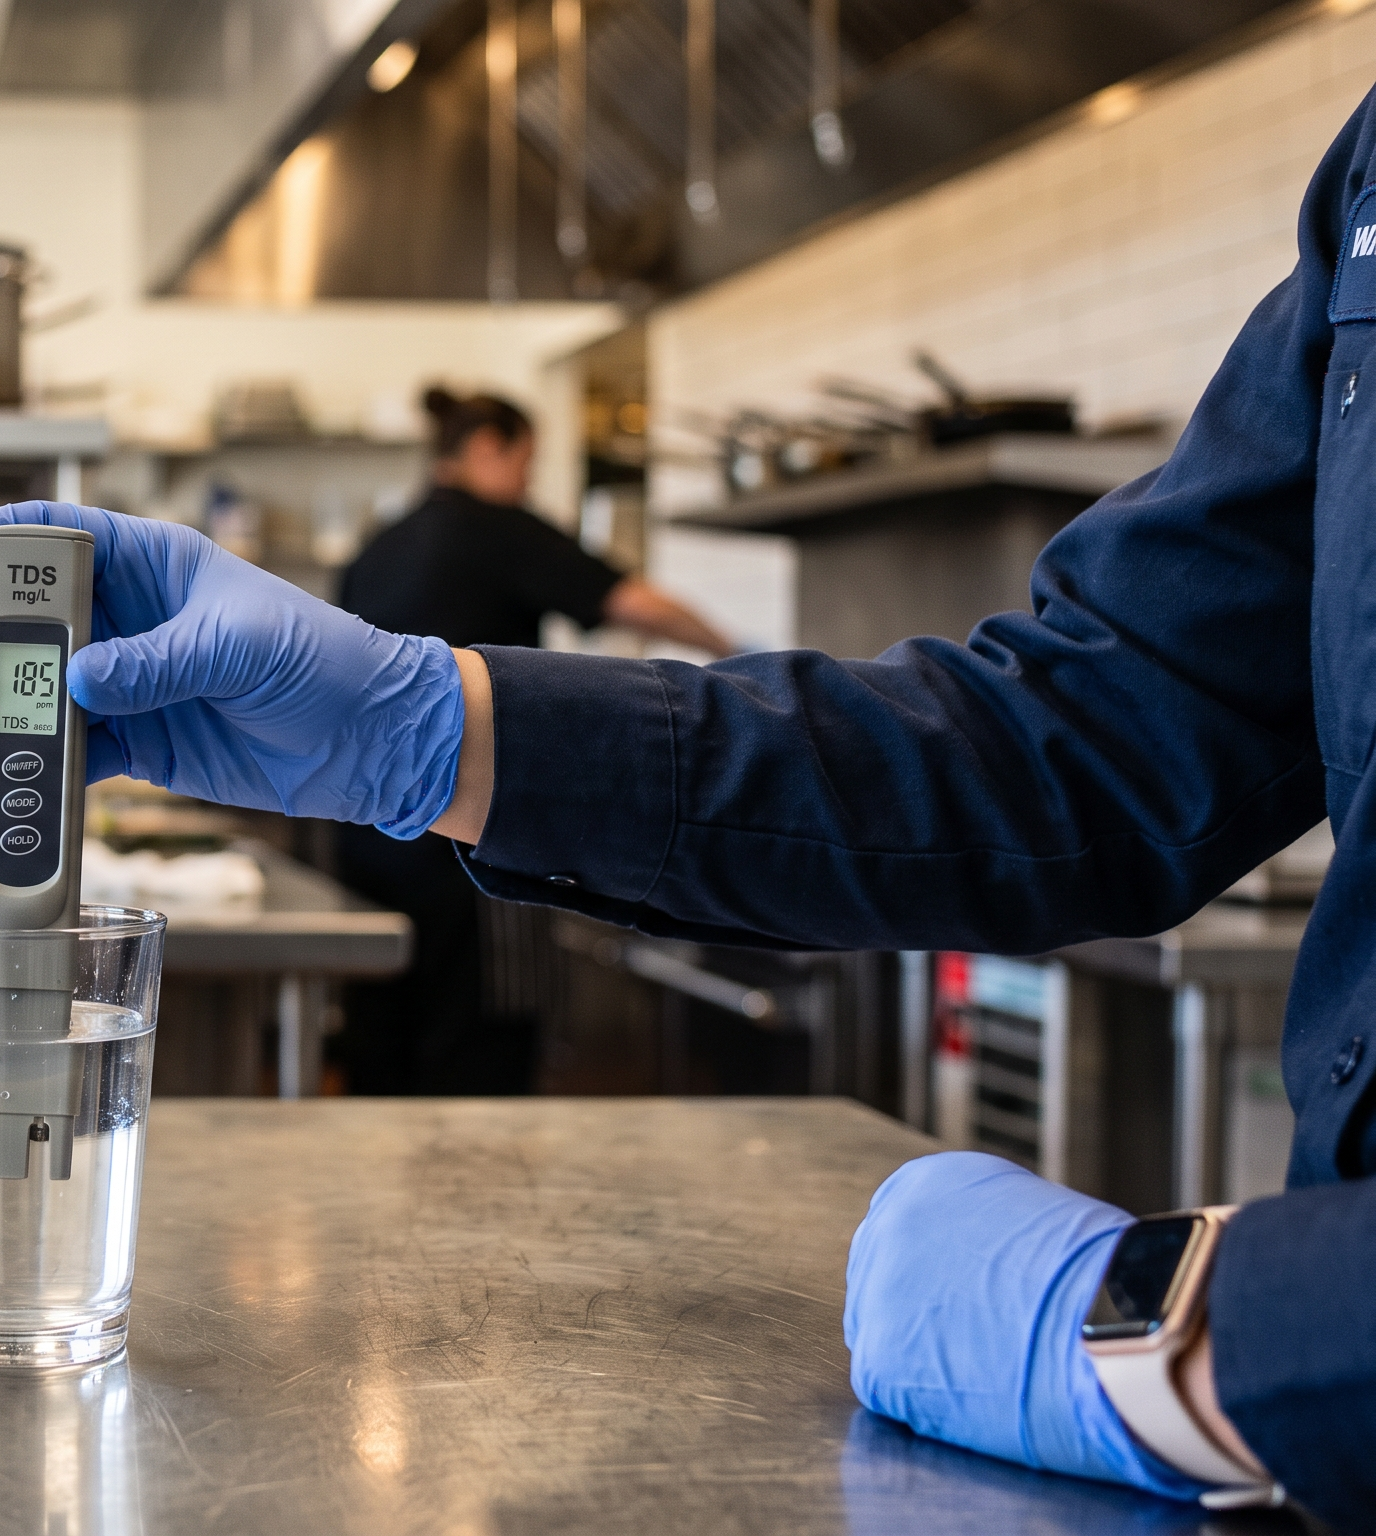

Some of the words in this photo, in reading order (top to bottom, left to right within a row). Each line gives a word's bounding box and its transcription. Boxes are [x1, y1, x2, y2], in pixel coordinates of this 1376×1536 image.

[7, 564, 57, 586] TDS
[12, 588, 51, 605] mg/L
[13, 661, 54, 697] 185
[1, 716, 29, 730] TDS
[6, 798, 36, 808] MODE
[7, 835, 35, 846] HOLD
